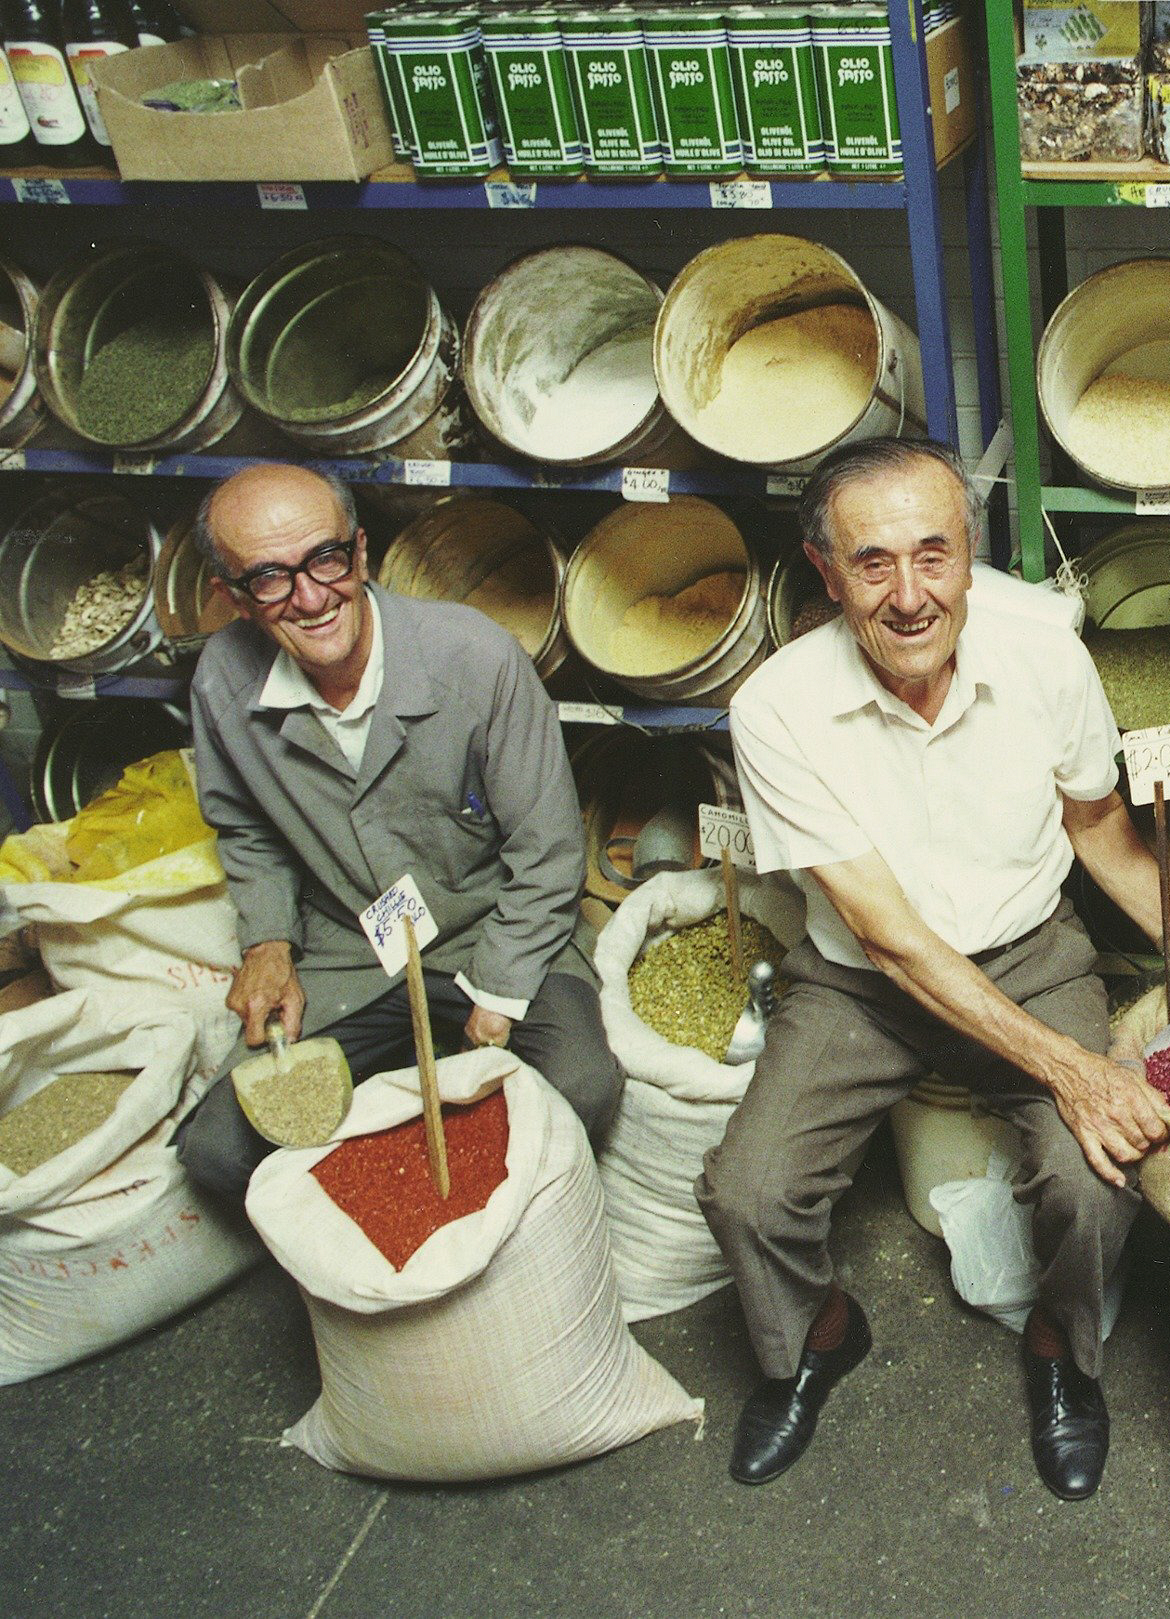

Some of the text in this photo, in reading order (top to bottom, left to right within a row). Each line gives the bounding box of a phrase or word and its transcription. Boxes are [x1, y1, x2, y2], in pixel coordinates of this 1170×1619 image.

[509, 62, 537, 74] OLIO
[589, 62, 616, 73] OLIO
[671, 60, 699, 72] OLIO
[755, 59, 784, 71] OLIO
[840, 58, 870, 70] OLIO
[413, 65, 441, 76] OLIO
